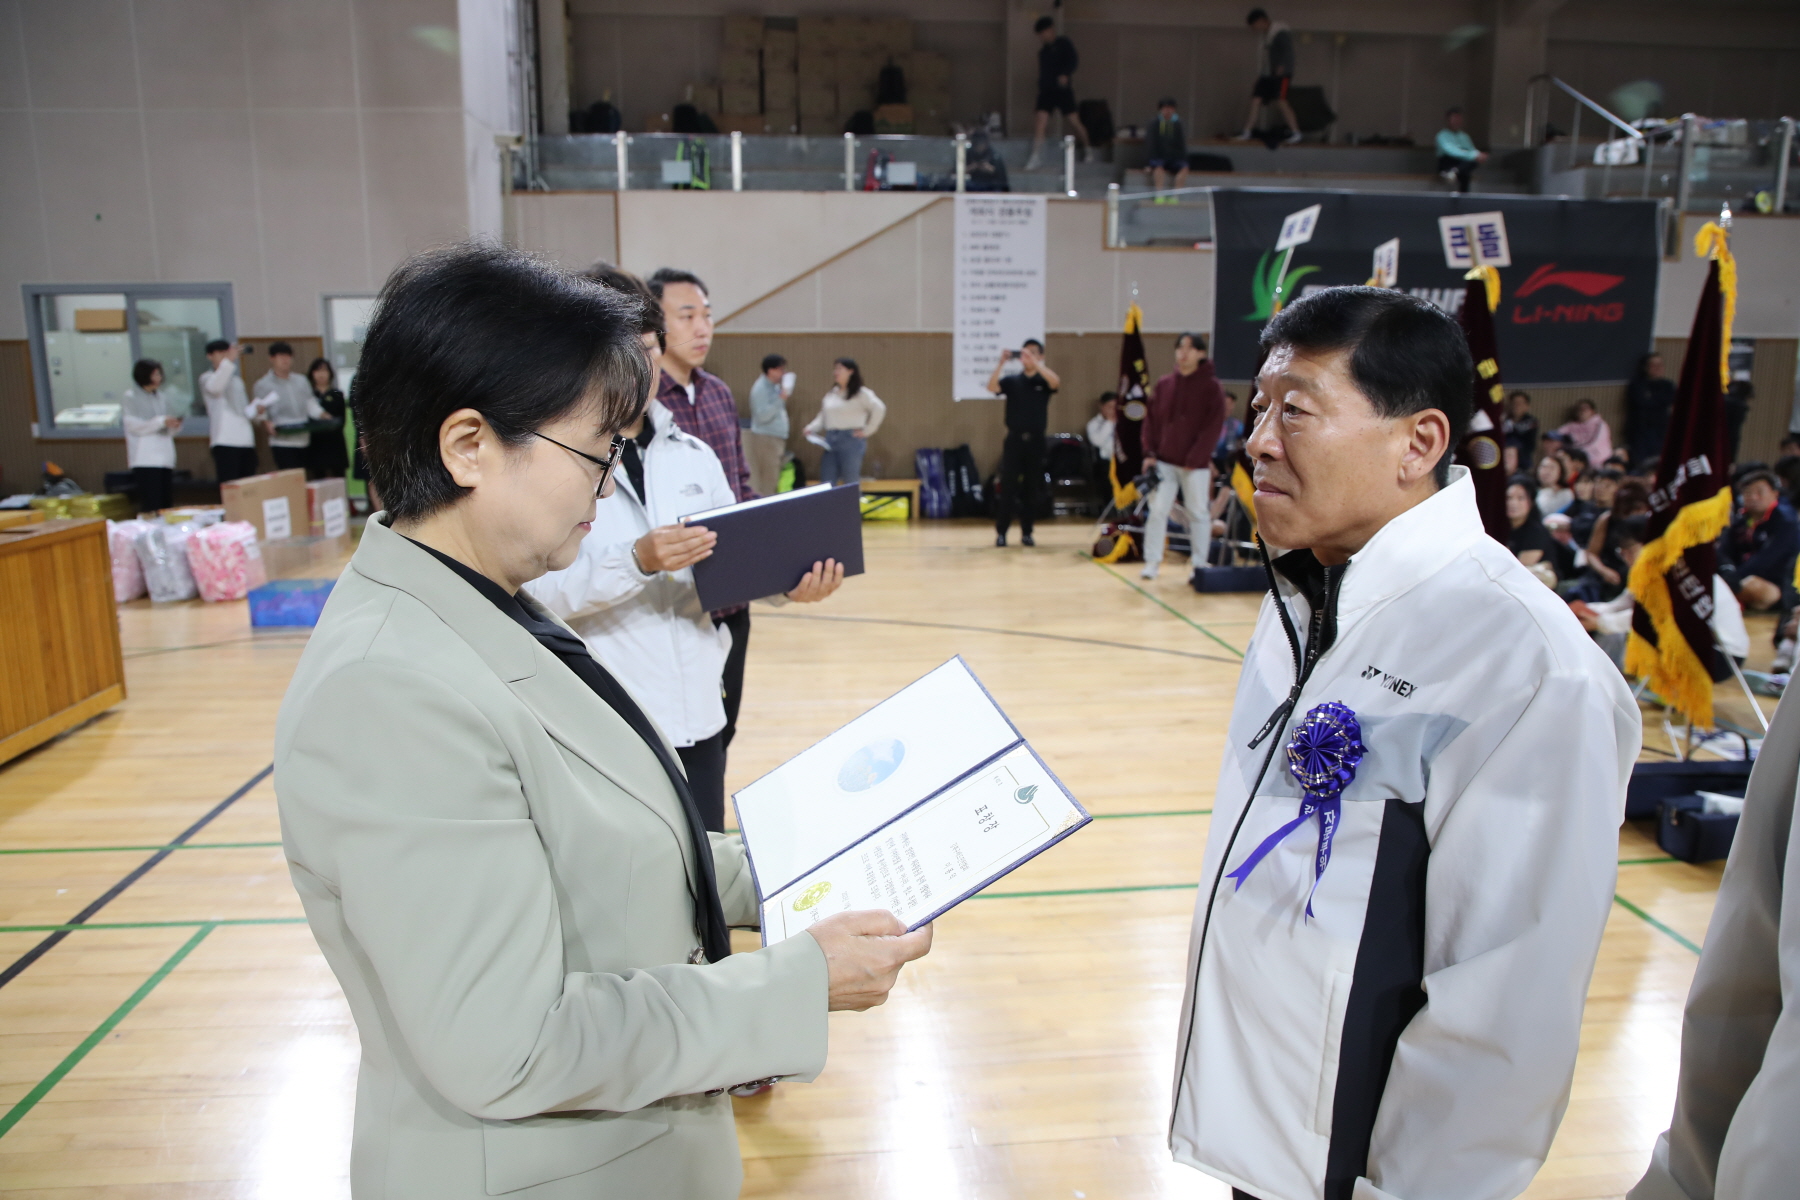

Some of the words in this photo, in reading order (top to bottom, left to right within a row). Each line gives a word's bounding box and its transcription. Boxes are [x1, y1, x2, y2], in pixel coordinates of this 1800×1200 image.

[1513, 302, 1625, 324] LI-NING
[1383, 673, 1418, 699] YONEX
[974, 804, 1000, 833] 표창장
